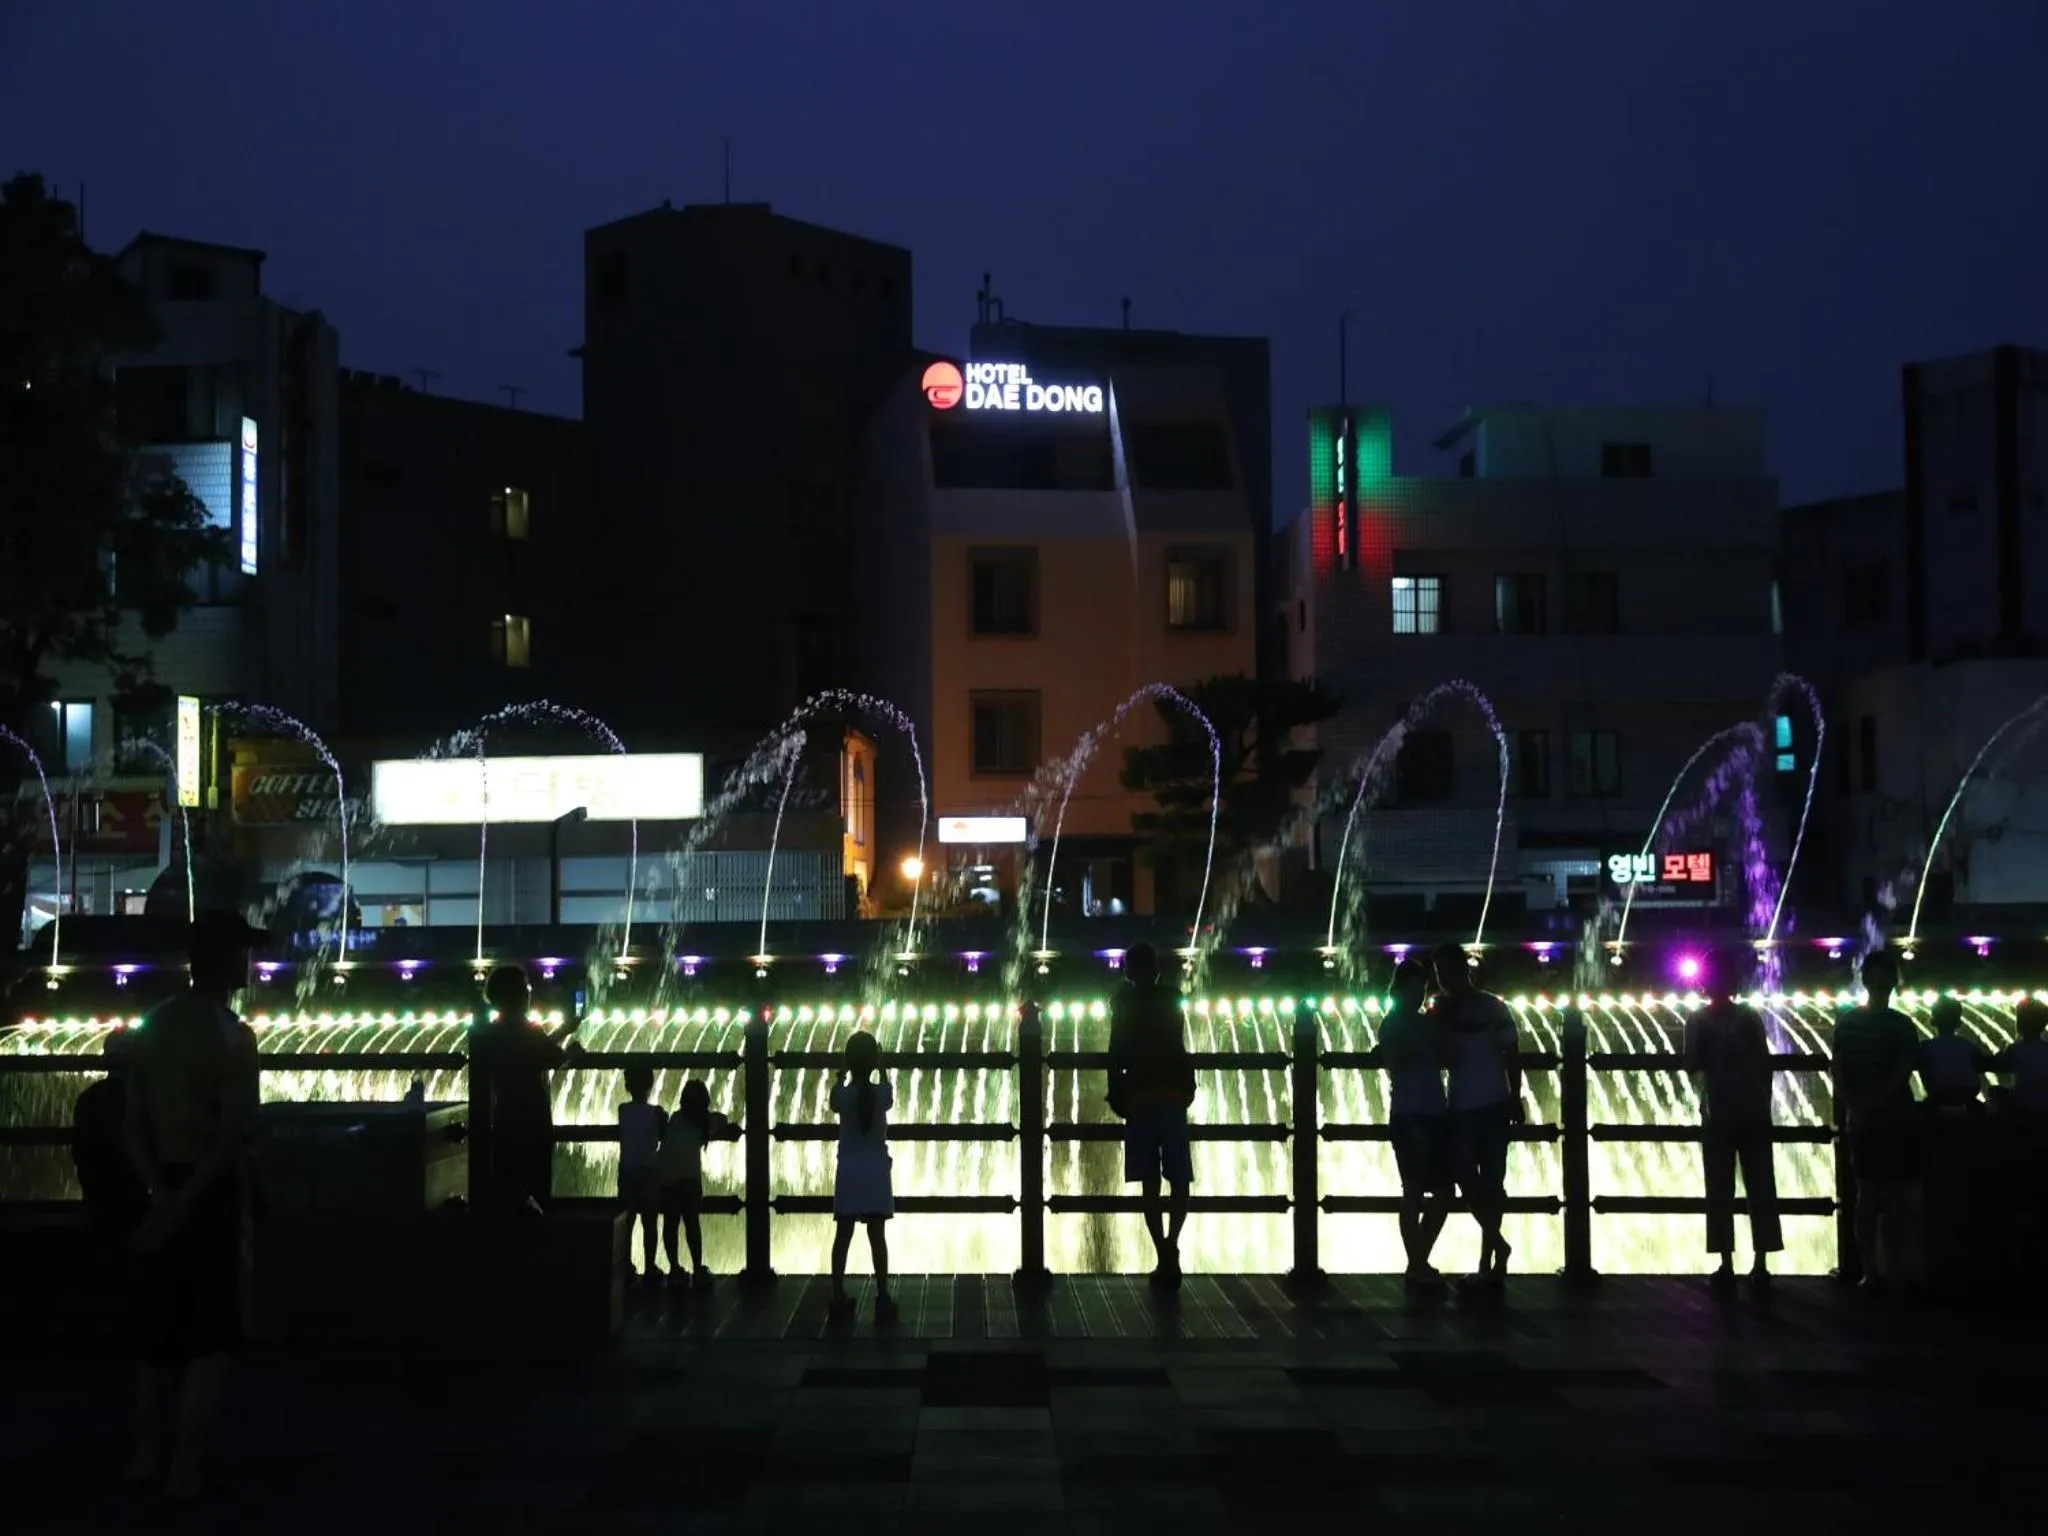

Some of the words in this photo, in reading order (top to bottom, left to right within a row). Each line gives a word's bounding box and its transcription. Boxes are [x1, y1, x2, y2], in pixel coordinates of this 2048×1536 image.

[966, 363, 1032, 385] HOTEL
[966, 384, 1020, 410] DAE
[1027, 385, 1102, 412] DONG
[1608, 853, 1656, 883] 영빈
[1662, 852, 1711, 881] 모텔
